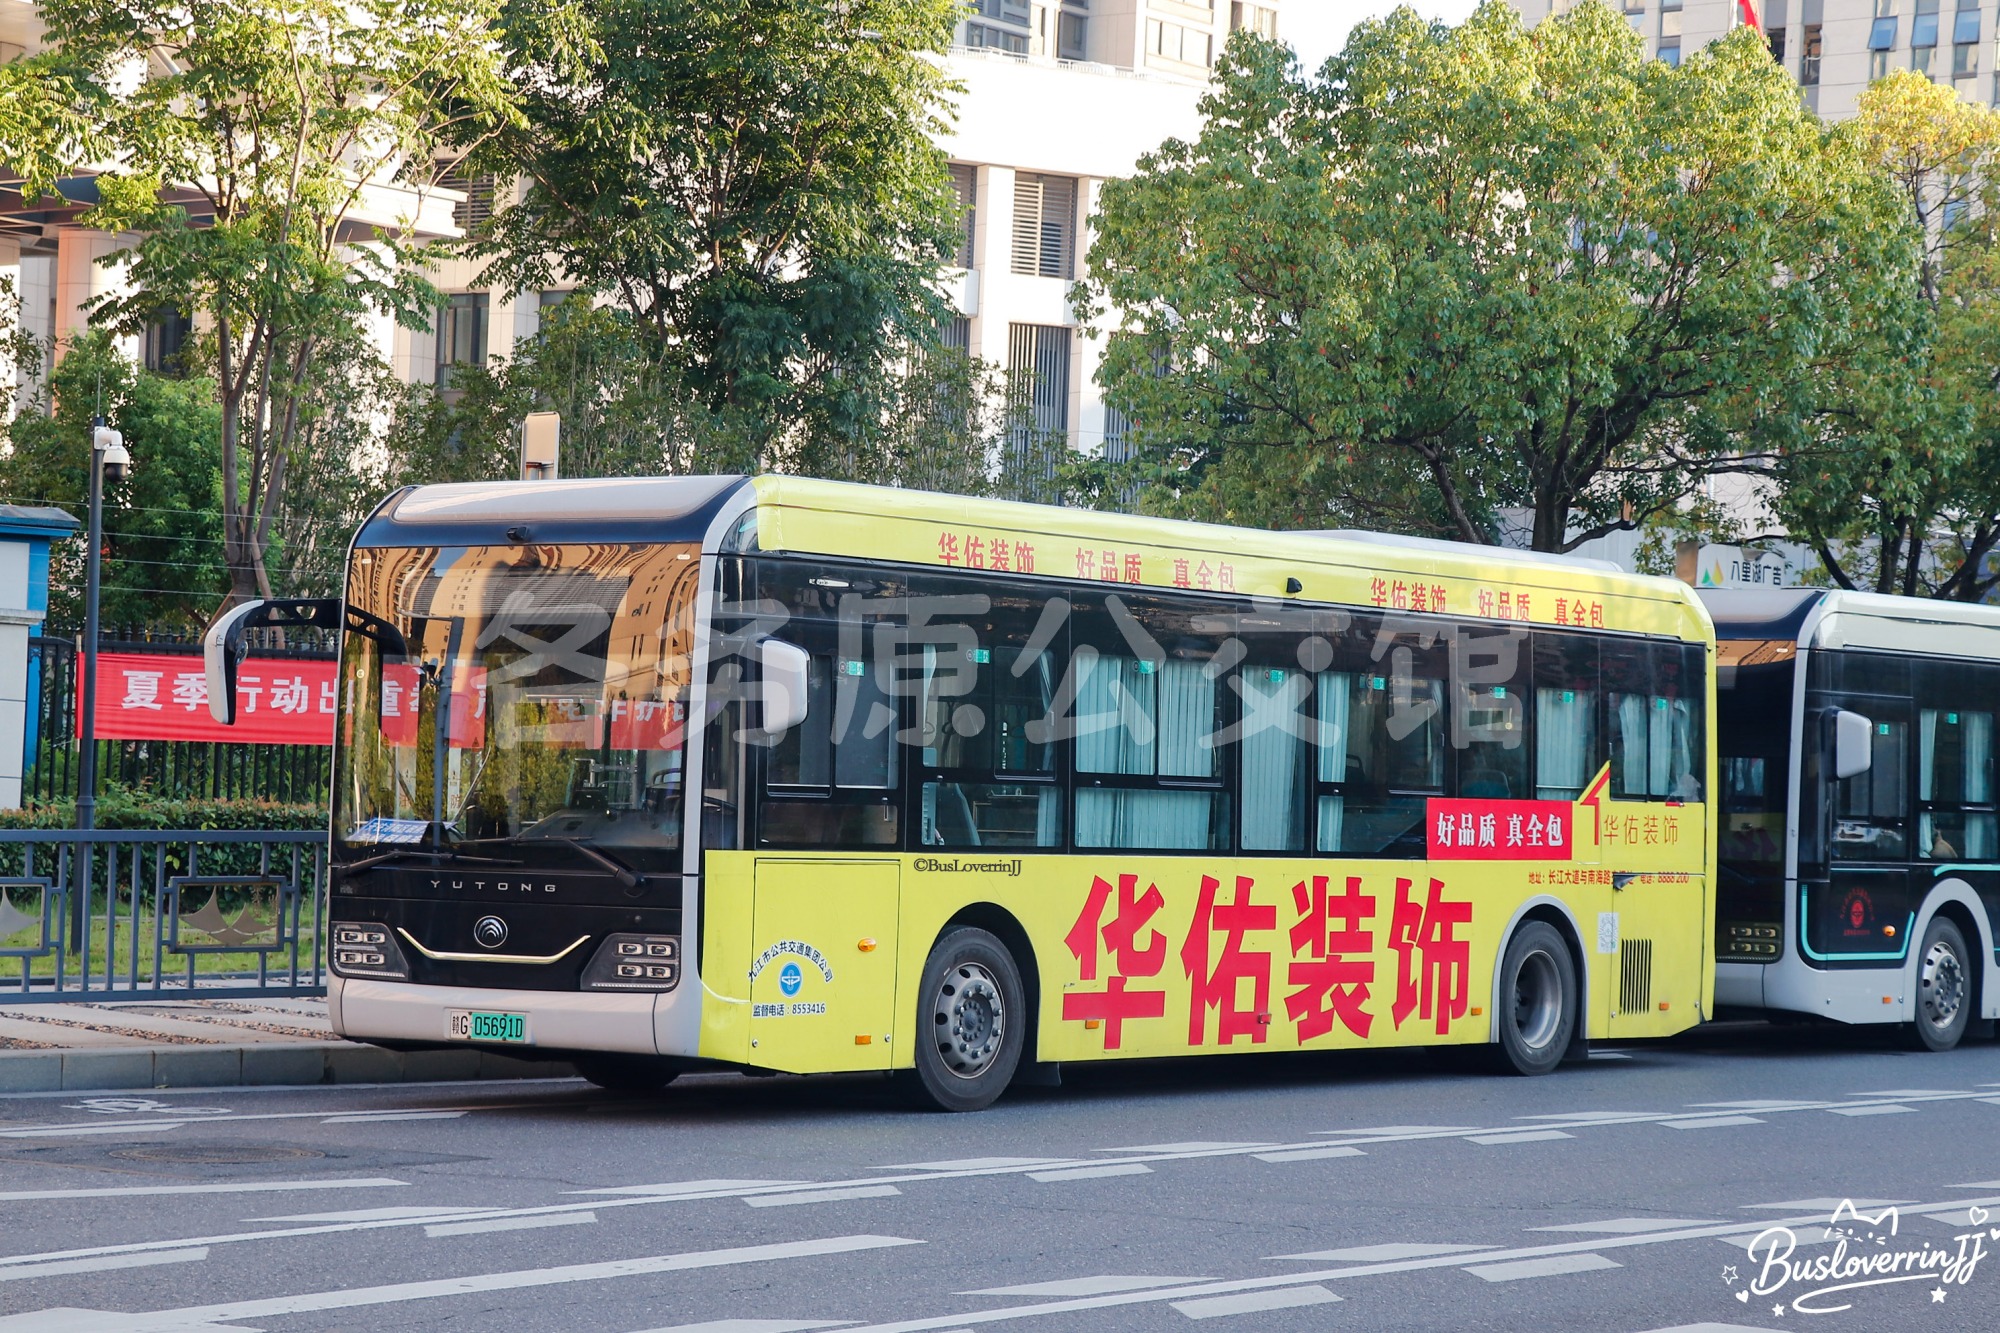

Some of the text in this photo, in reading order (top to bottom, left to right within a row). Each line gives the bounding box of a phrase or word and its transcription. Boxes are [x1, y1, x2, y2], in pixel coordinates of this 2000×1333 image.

[938, 532, 1236, 593] 华佑装饰 好品质 真全包
[1731, 560, 1781, 585] 八里湖广告
[1370, 577, 1604, 628] 华佑装饰 好品质 真全包
[1436, 812, 1564, 847] 好品质 真全包
[1603, 814, 1679, 846] 华佑装饰
[431, 880, 556, 893] YUTONG
[747, 940, 833, 983] 九江市公共交通集团公司
[1062, 874, 1473, 1050] 华佑装饰
